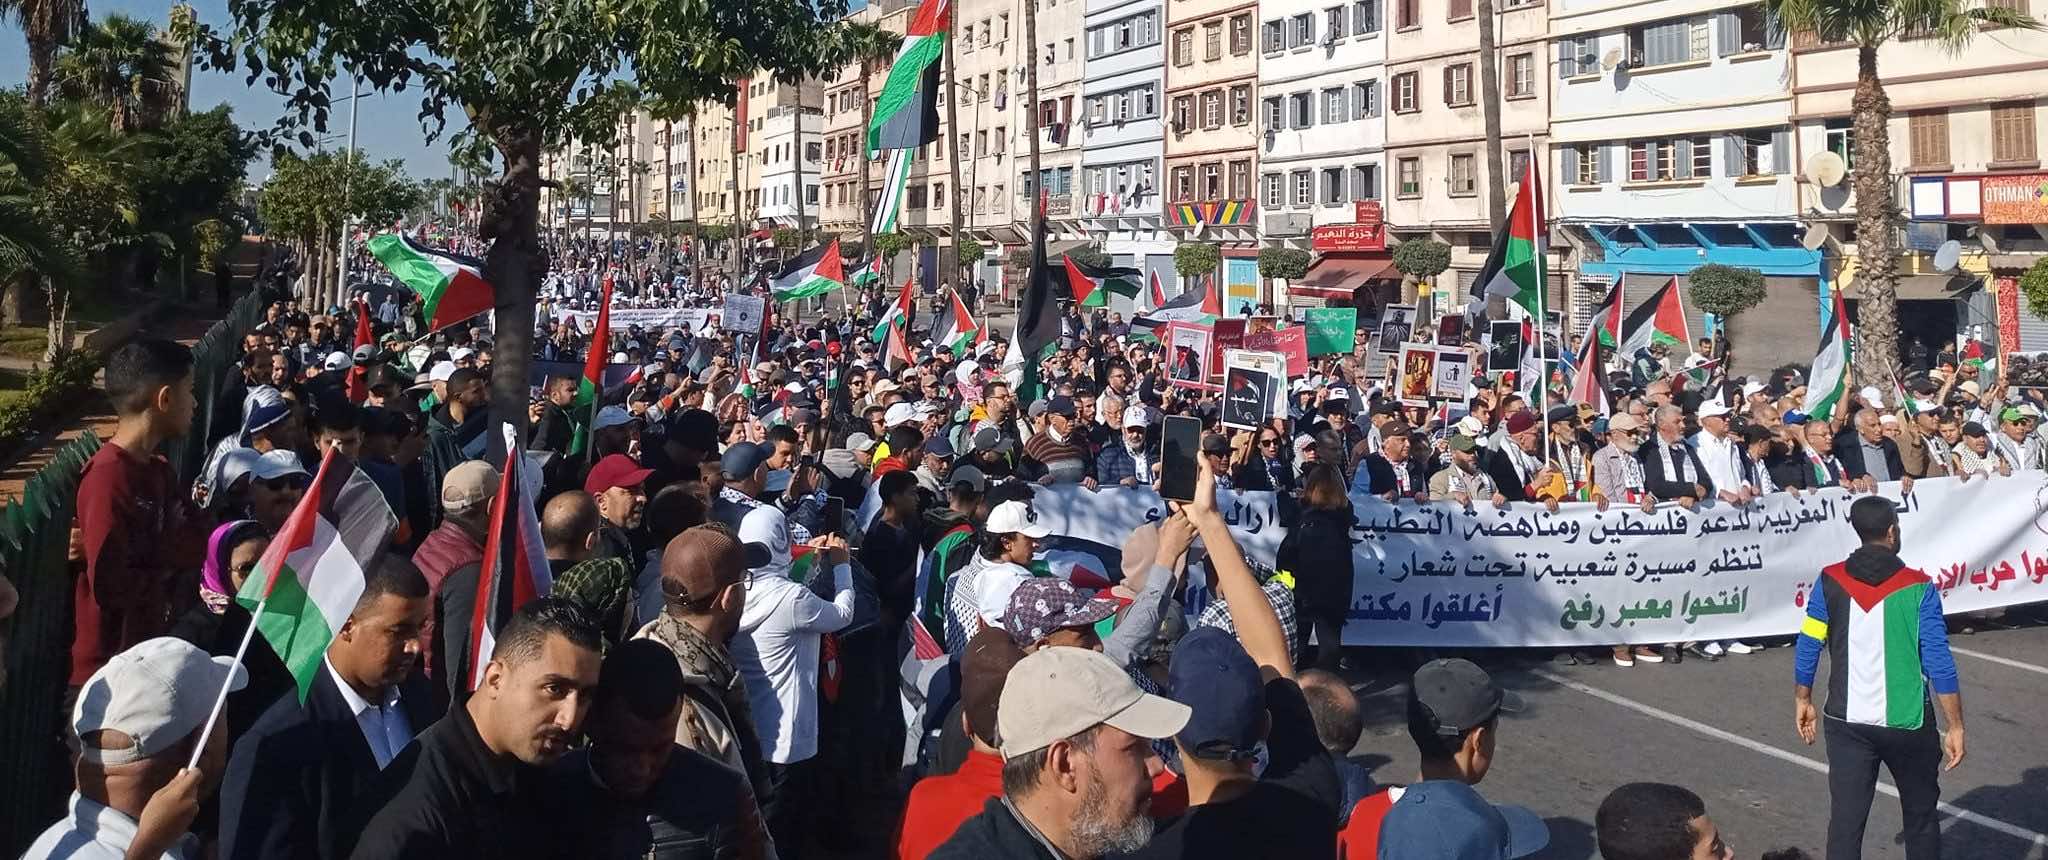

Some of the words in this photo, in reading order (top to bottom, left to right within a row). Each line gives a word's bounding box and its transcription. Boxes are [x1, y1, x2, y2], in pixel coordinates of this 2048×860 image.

[1985, 186, 2033, 203] OTHMAN
[1463, 509, 1580, 544] ومناهضة
[1589, 510, 1688, 544] فلسطين
[1695, 507, 1751, 538] لدعم
[1757, 497, 1836, 534] المغربية
[1391, 550, 1457, 583] شعار
[1464, 552, 1527, 577] تحت
[1533, 551, 1618, 585] شعبية
[1624, 552, 1697, 584] مسيرة
[1702, 543, 1763, 577] تنظم
[1970, 560, 2017, 592] حرب
[1421, 583, 1504, 629] أغلقوا
[1559, 592, 1606, 630] رفح
[1609, 597, 1674, 628] معبر
[1680, 585, 1750, 625] افتحوا
